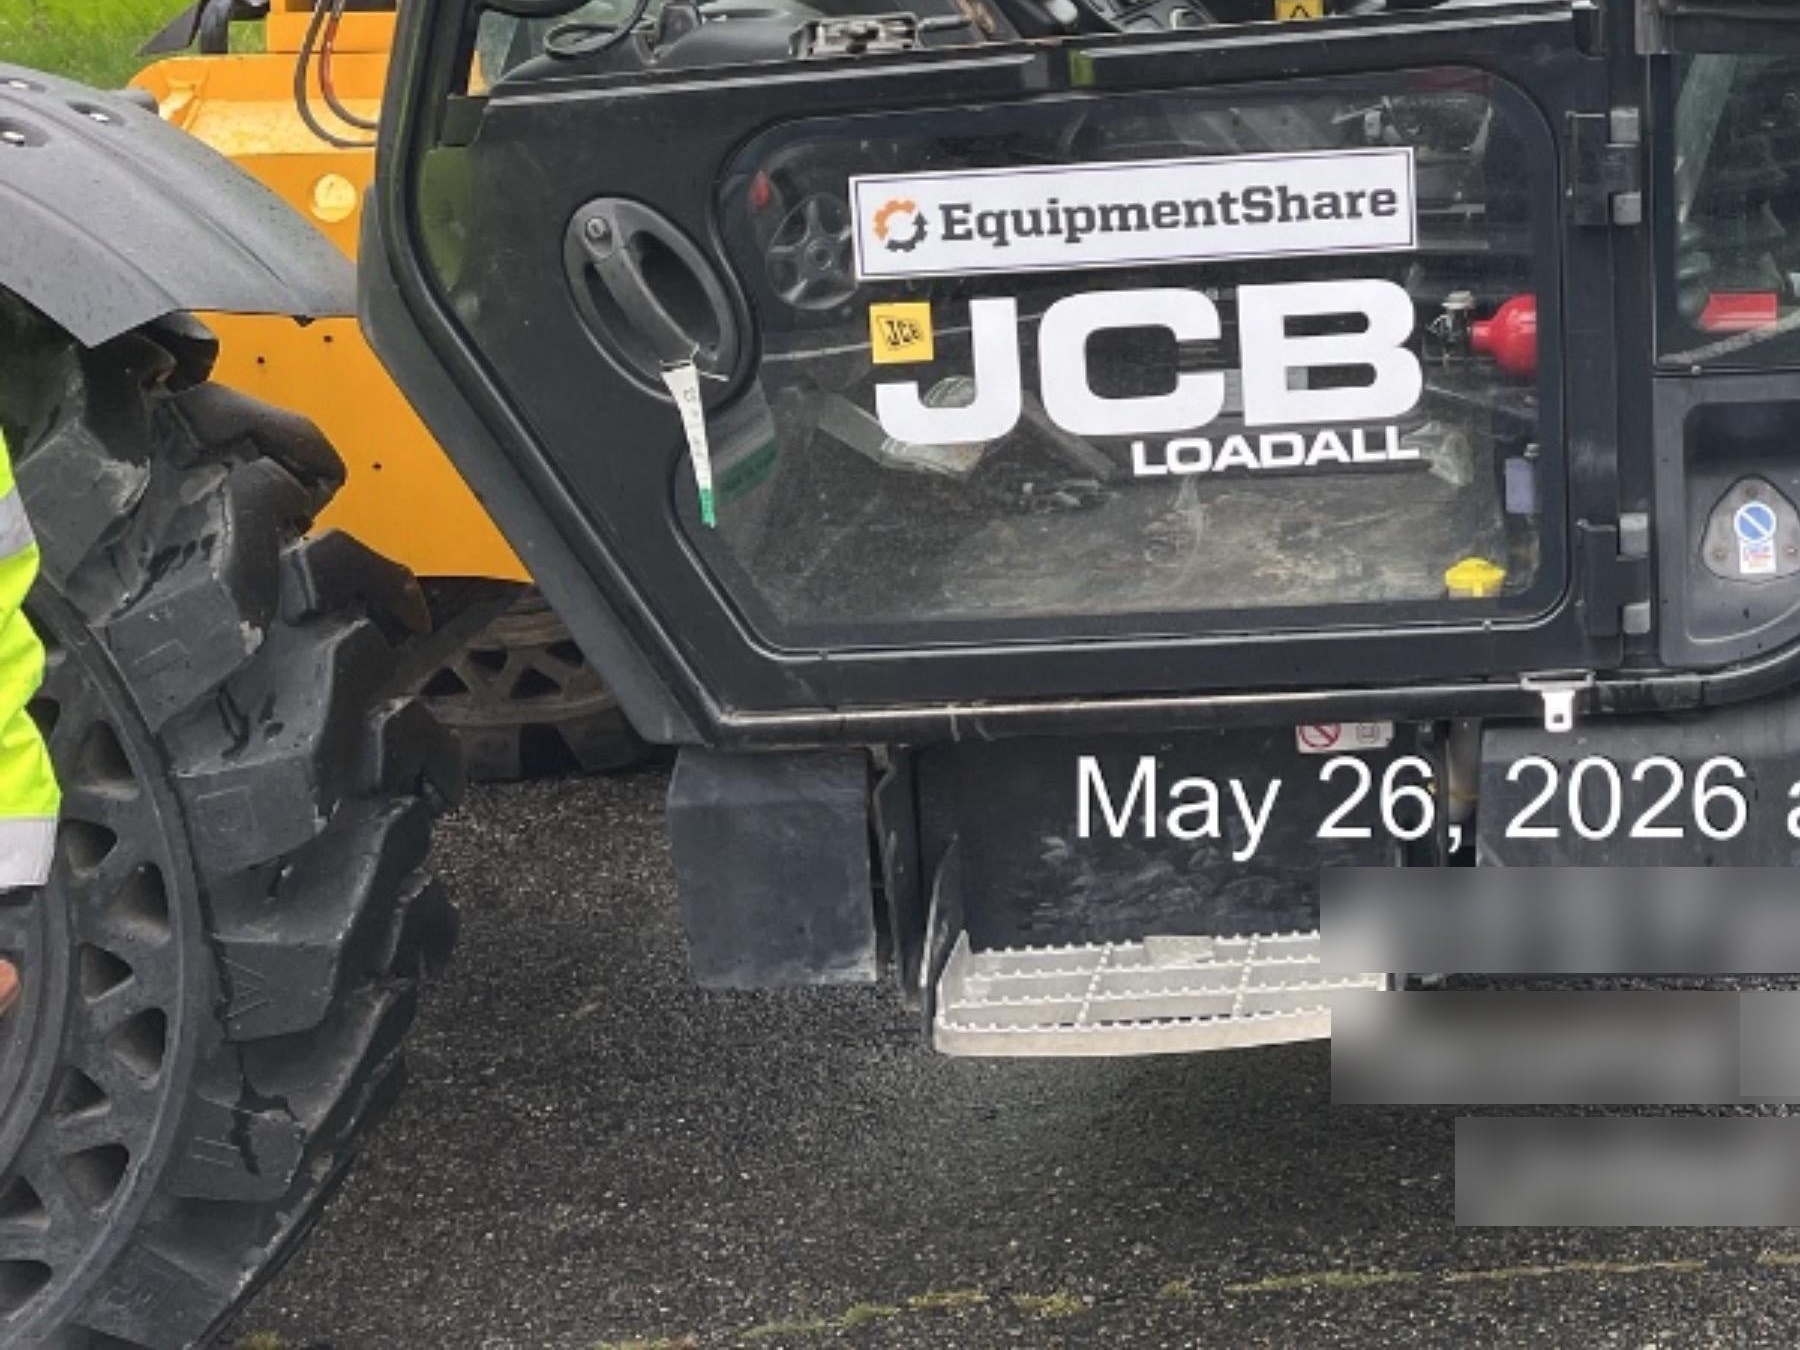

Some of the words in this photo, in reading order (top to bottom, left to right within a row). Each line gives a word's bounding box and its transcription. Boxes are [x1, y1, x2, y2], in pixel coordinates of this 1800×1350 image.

[938, 185, 1398, 246] EquipmentShare
[875, 278, 1423, 446] JCB
[1131, 425, 1420, 477] LOADALL
